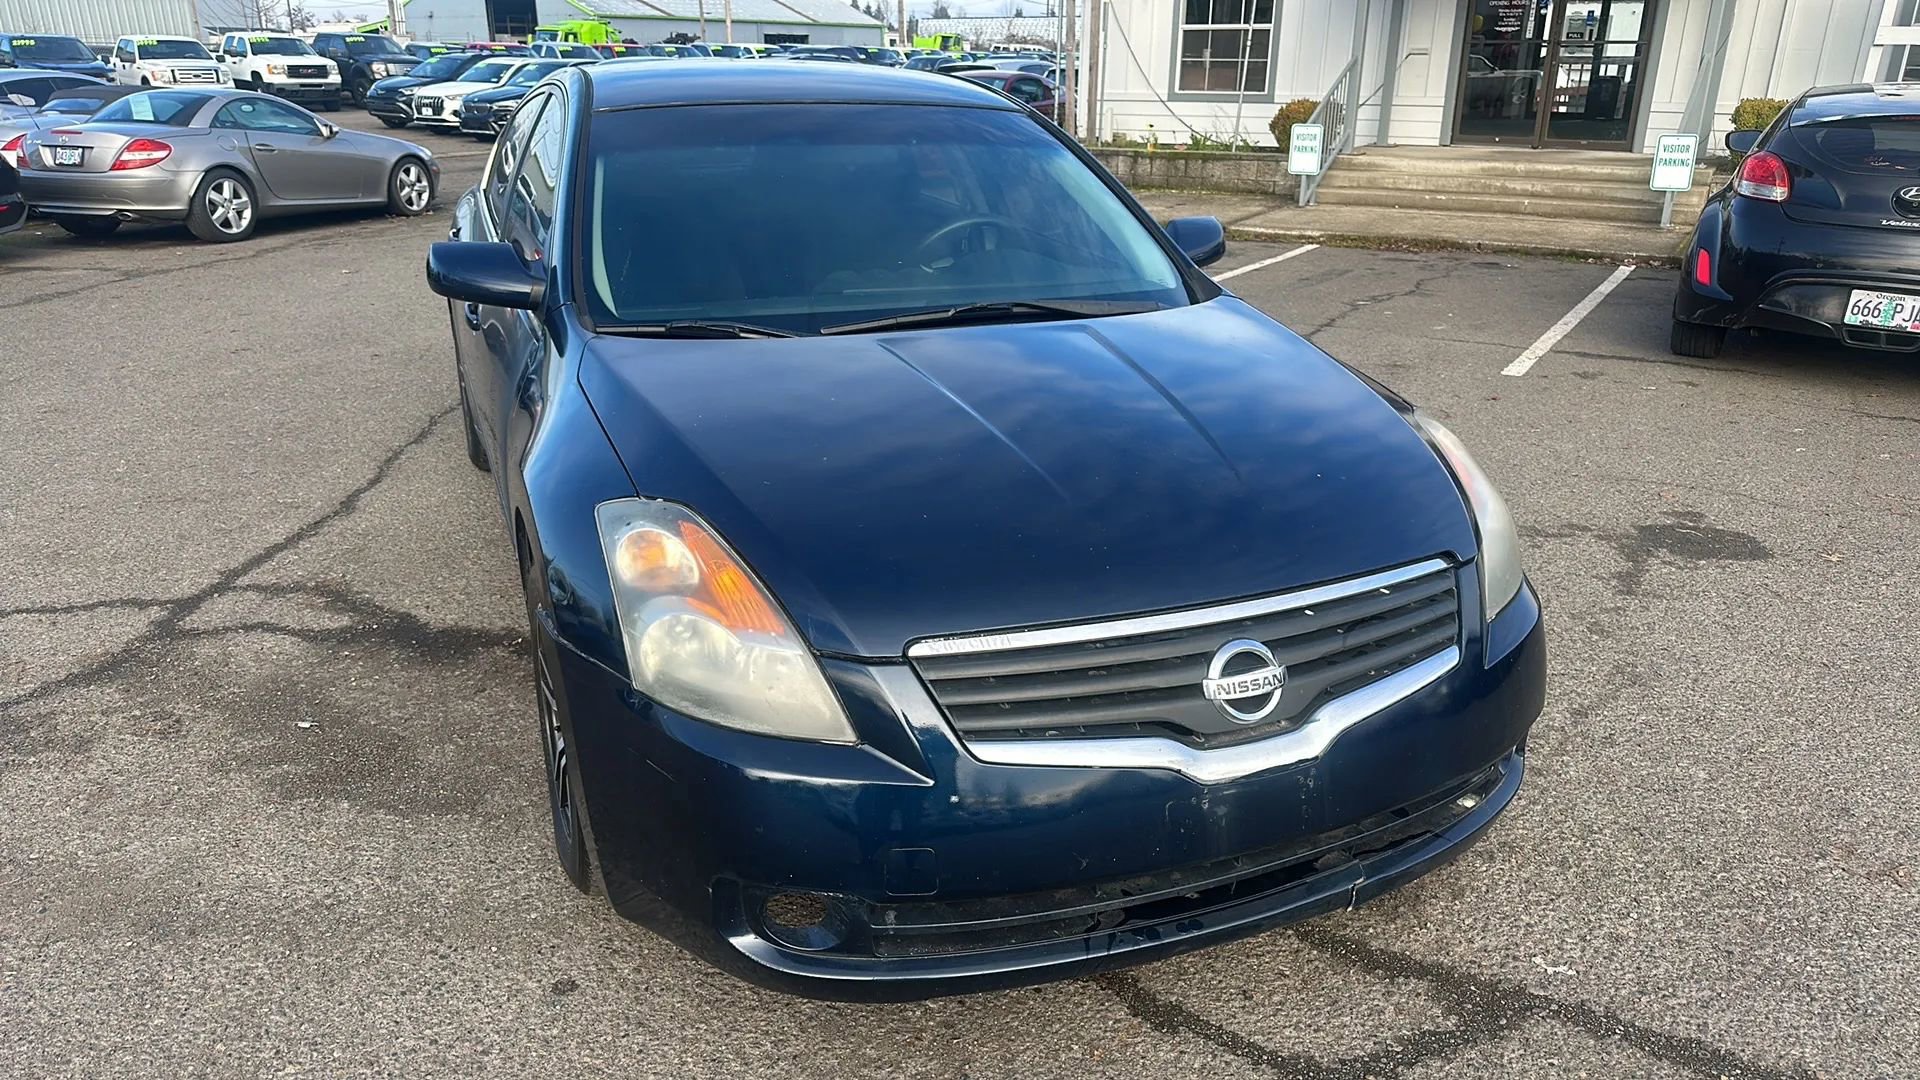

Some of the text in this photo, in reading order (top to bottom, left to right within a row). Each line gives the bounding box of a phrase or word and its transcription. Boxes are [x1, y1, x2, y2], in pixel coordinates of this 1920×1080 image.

[1296, 133, 1317, 141] VISITOR
[1293, 145, 1317, 153] PARKING
[1663, 144, 1690, 153] VISITOR
[1659, 157, 1690, 167] PARKING
[1876, 293, 1905, 302] Oregon
[1850, 299, 1882, 318] 666
[1216, 671, 1283, 696] NISSAN
